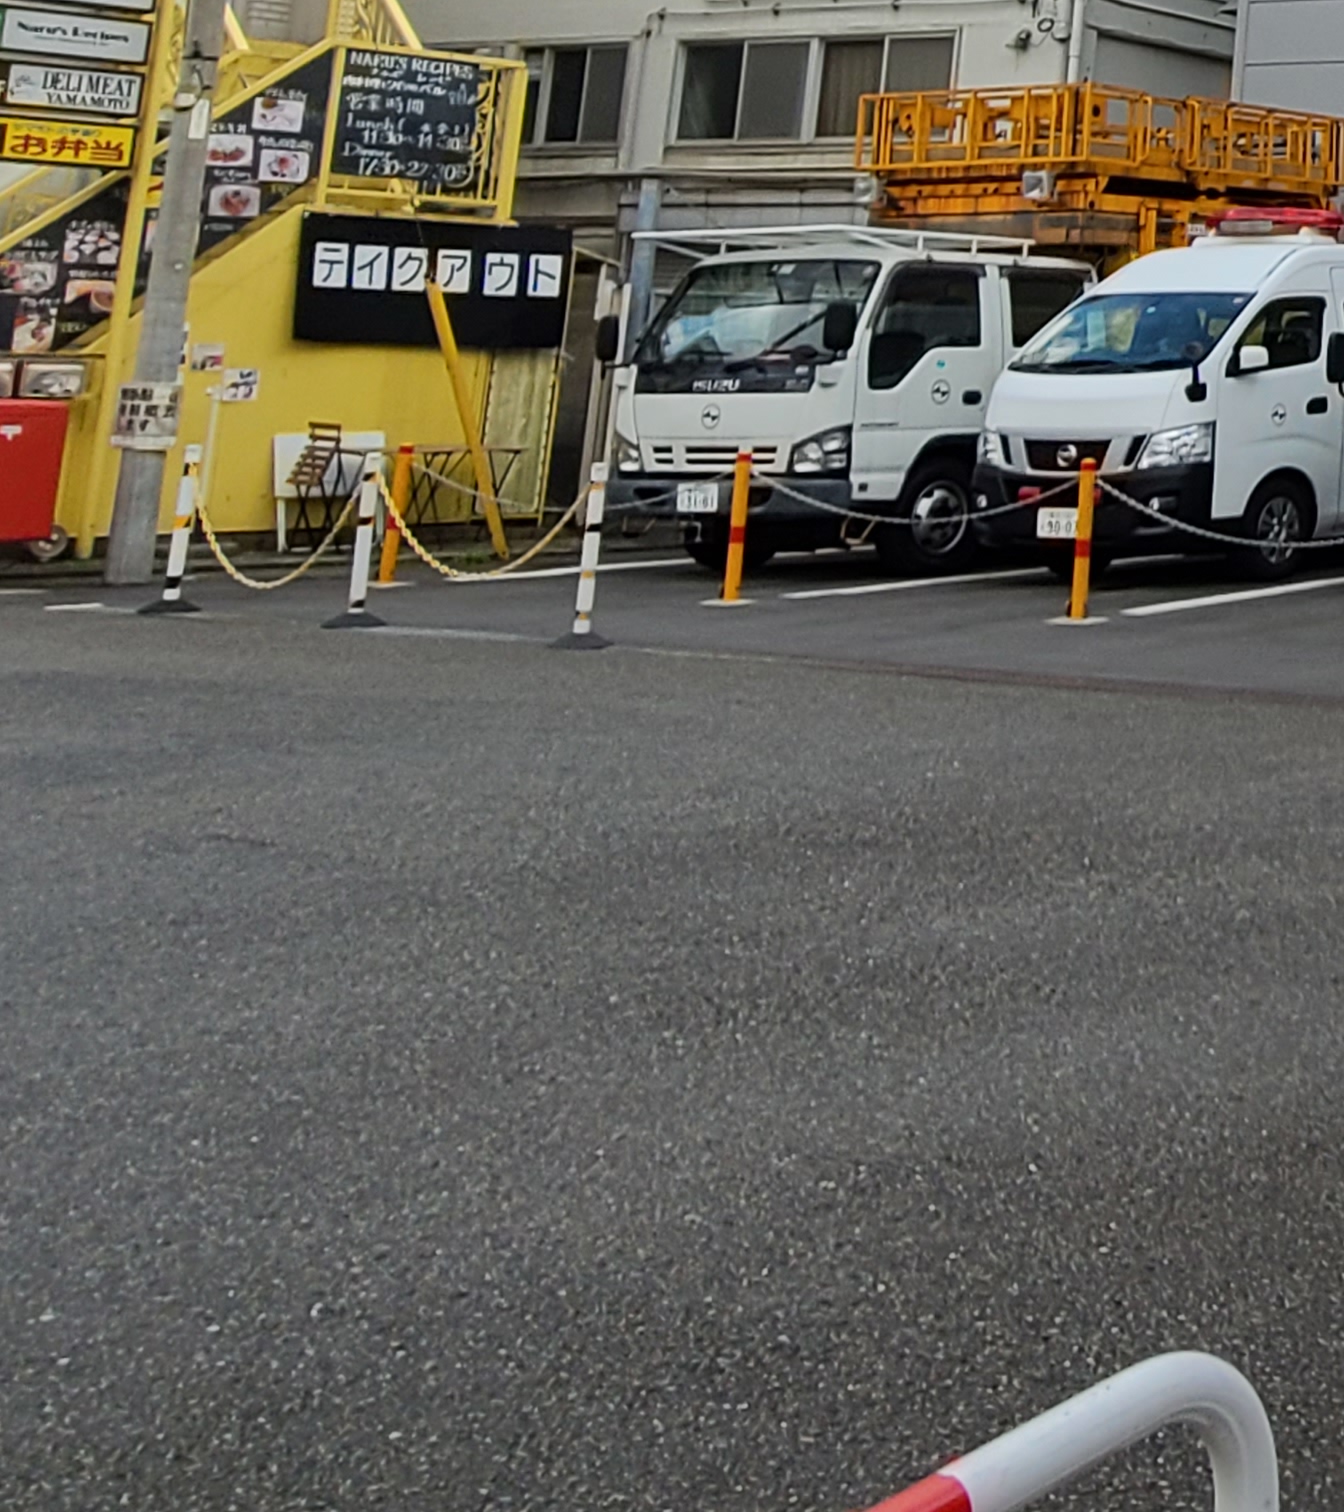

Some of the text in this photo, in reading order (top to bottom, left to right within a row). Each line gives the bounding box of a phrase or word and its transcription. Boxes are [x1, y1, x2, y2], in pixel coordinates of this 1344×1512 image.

[42, 70, 137, 99] DELI MEAT
[46, 92, 130, 111] YAMAMOTO
[10, 133, 125, 162] お弁当
[318, 246, 557, 293] テイクアウト
[692, 378, 741, 392] ISUZU
